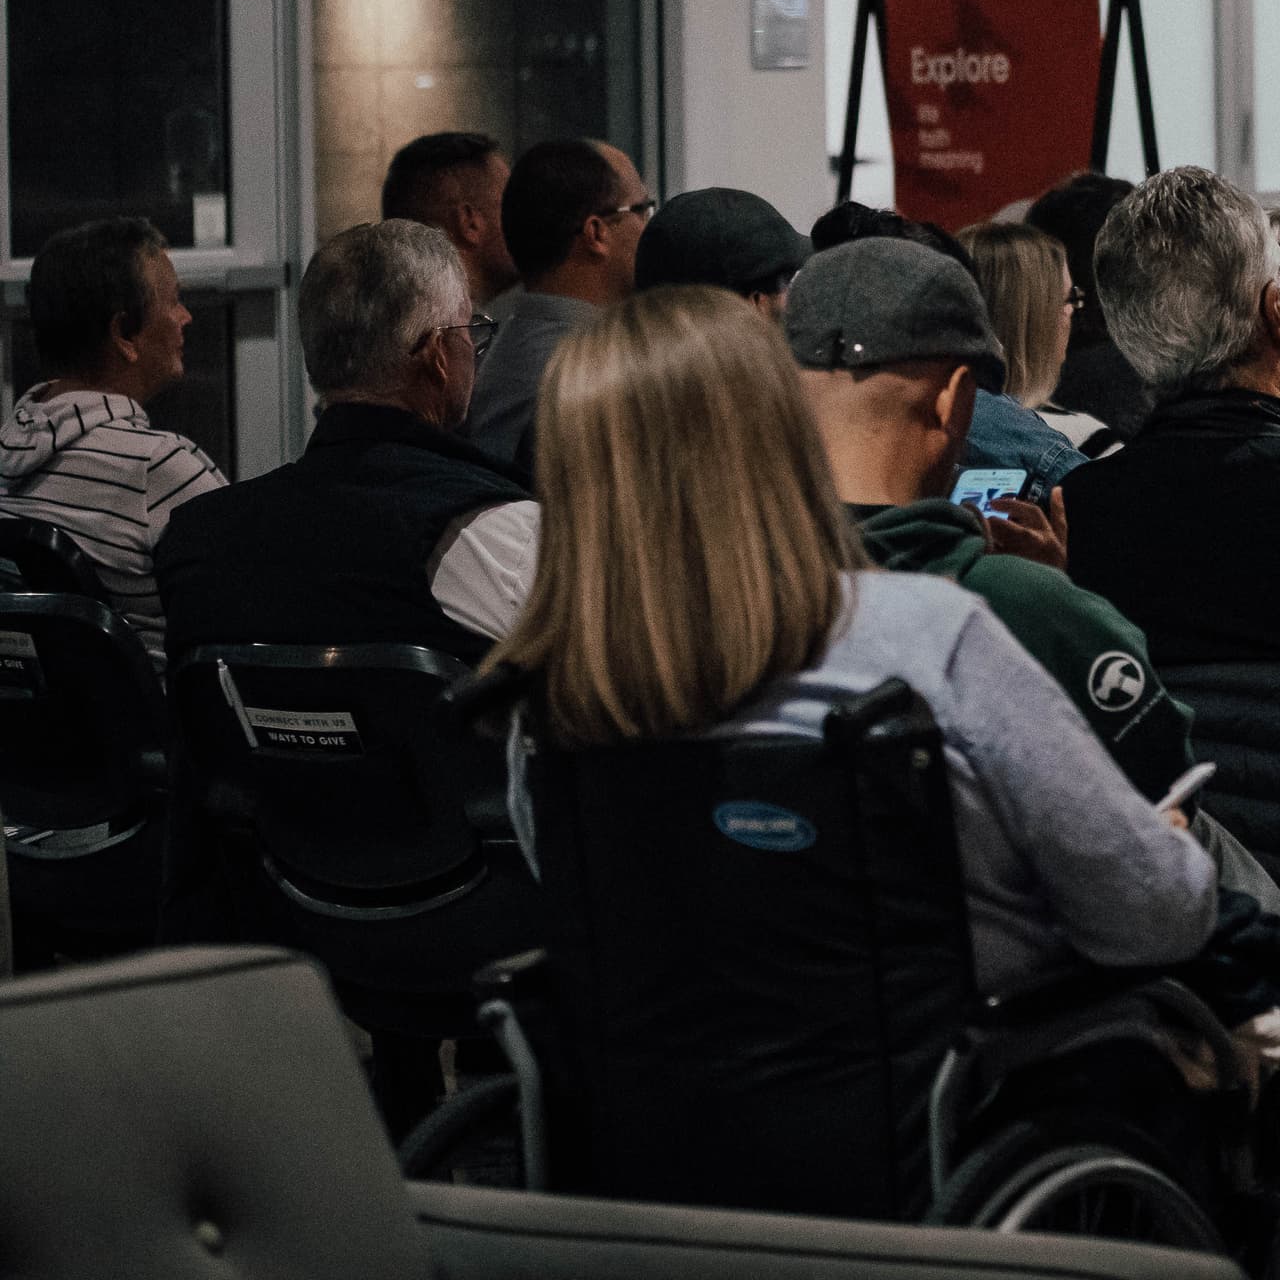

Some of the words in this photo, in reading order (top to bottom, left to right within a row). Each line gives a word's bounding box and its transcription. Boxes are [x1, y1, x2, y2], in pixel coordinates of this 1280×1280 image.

[910, 47, 1010, 91] Explore
[267, 731, 298, 744] WAYS
[299, 735, 316, 746] TO
[319, 736, 347, 747] GIVE
